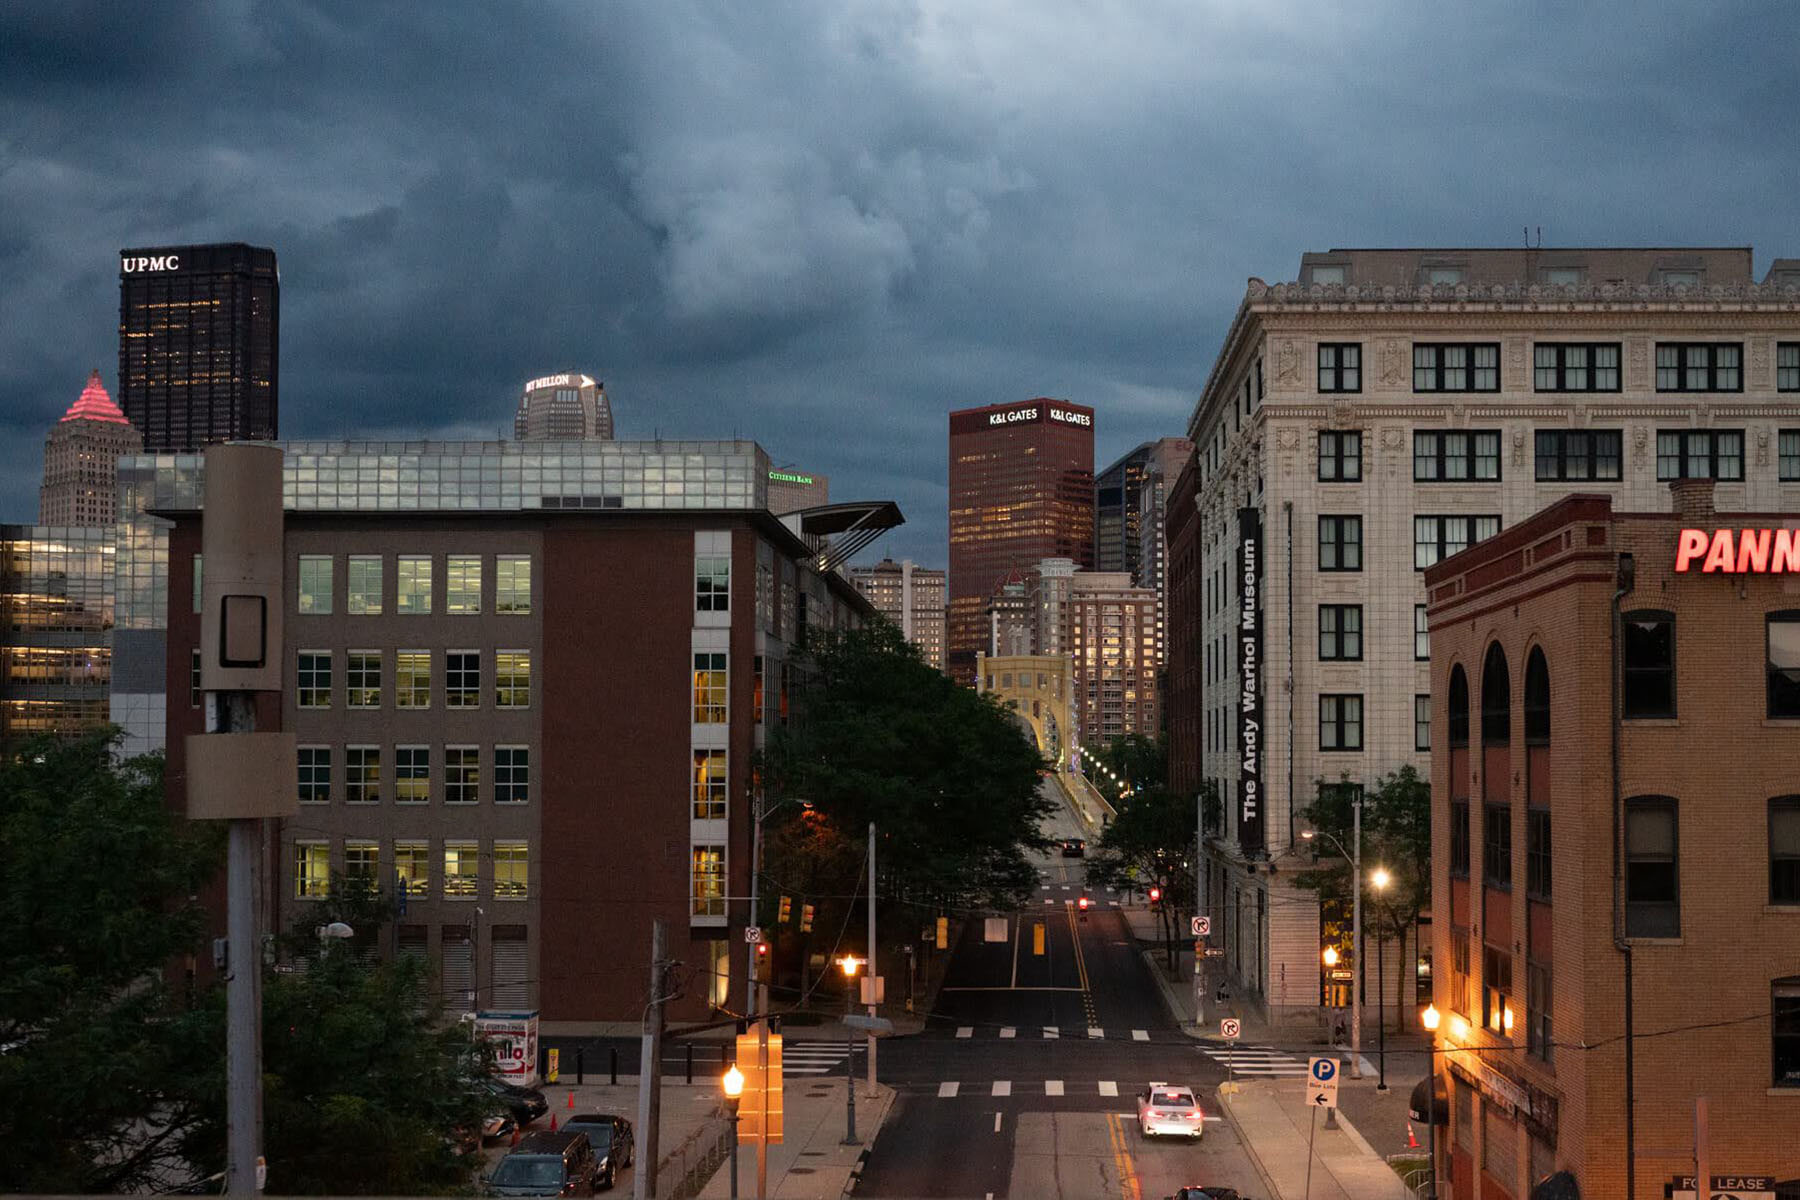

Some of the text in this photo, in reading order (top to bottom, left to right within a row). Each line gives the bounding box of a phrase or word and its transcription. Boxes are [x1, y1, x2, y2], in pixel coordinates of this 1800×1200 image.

[122, 255, 179, 273] UPMC
[536, 375, 569, 389] MELLON
[989, 408, 1038, 425] K&L GATES
[1050, 408, 1090, 426] K&L GATES
[1243, 538, 1259, 824] The Andy Warhol Museum
[1318, 1062, 1331, 1078] P
[1682, 1177, 1766, 1190] FO LEASE
